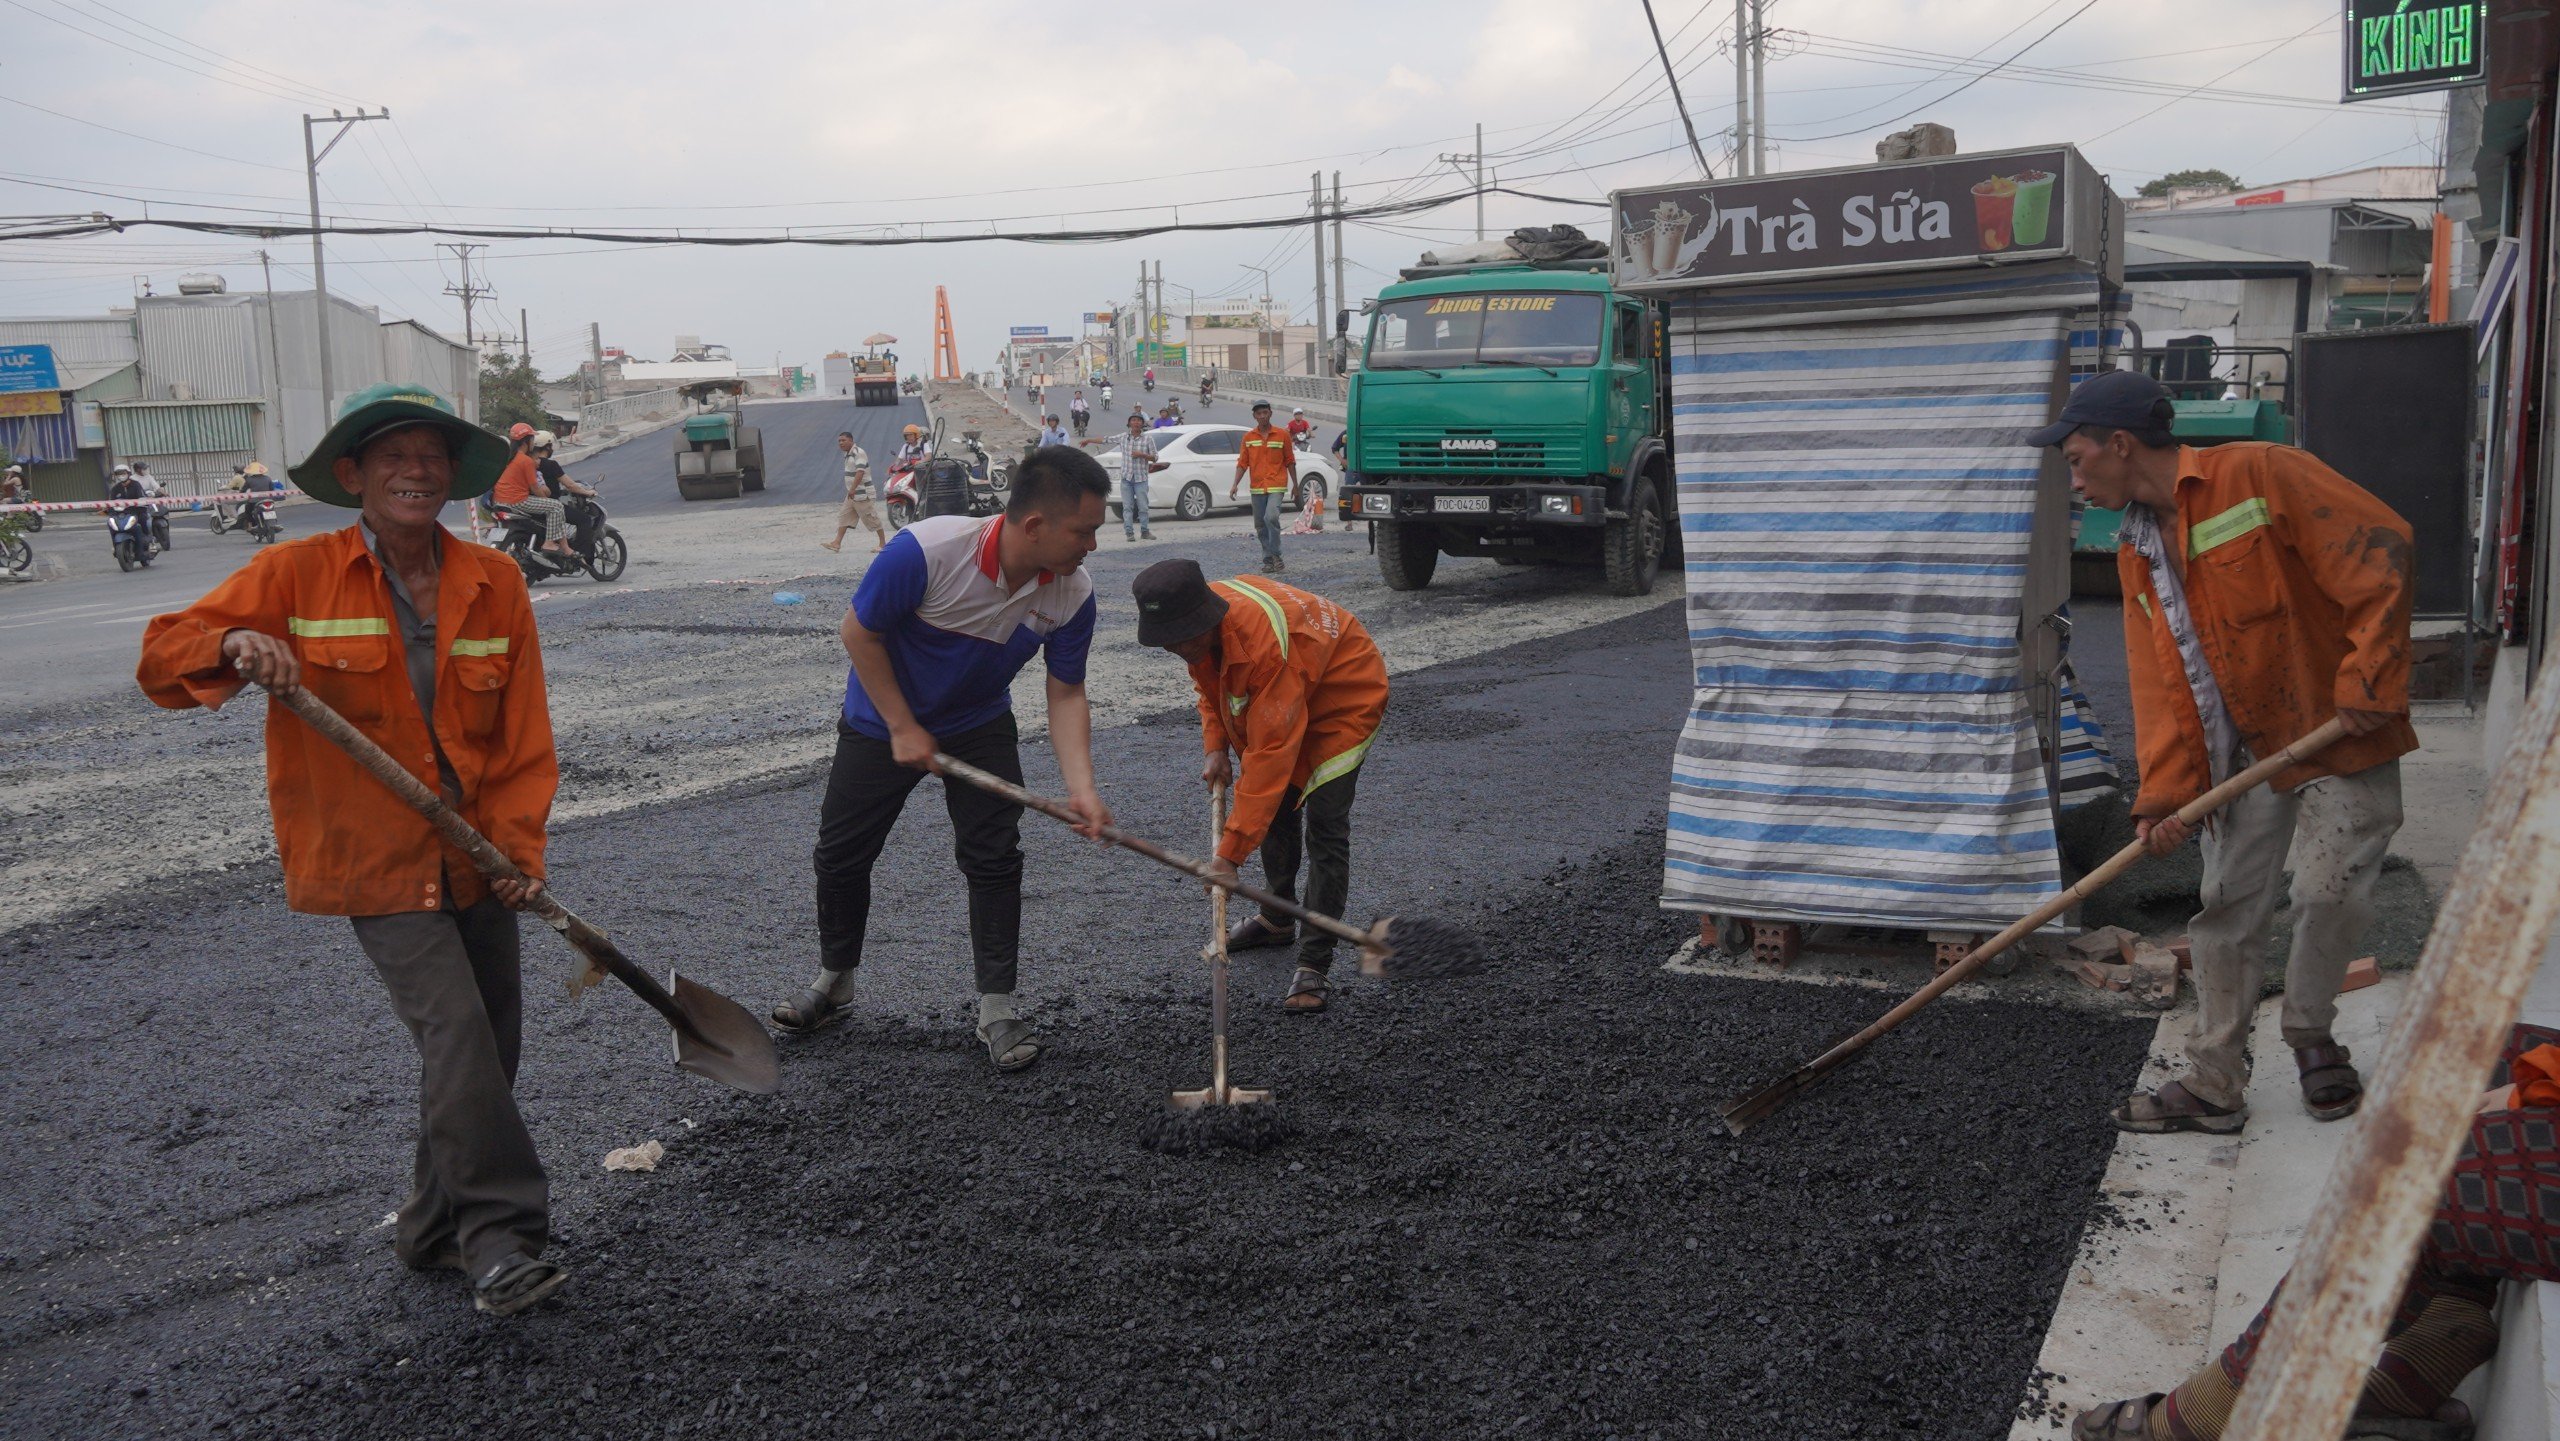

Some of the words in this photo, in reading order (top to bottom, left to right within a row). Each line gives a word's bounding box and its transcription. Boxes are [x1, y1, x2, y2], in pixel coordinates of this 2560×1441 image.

[2362, 0, 2473, 78] KÍNH
[1719, 197, 1819, 256] Trà
[1842, 188, 1952, 247] Sữa
